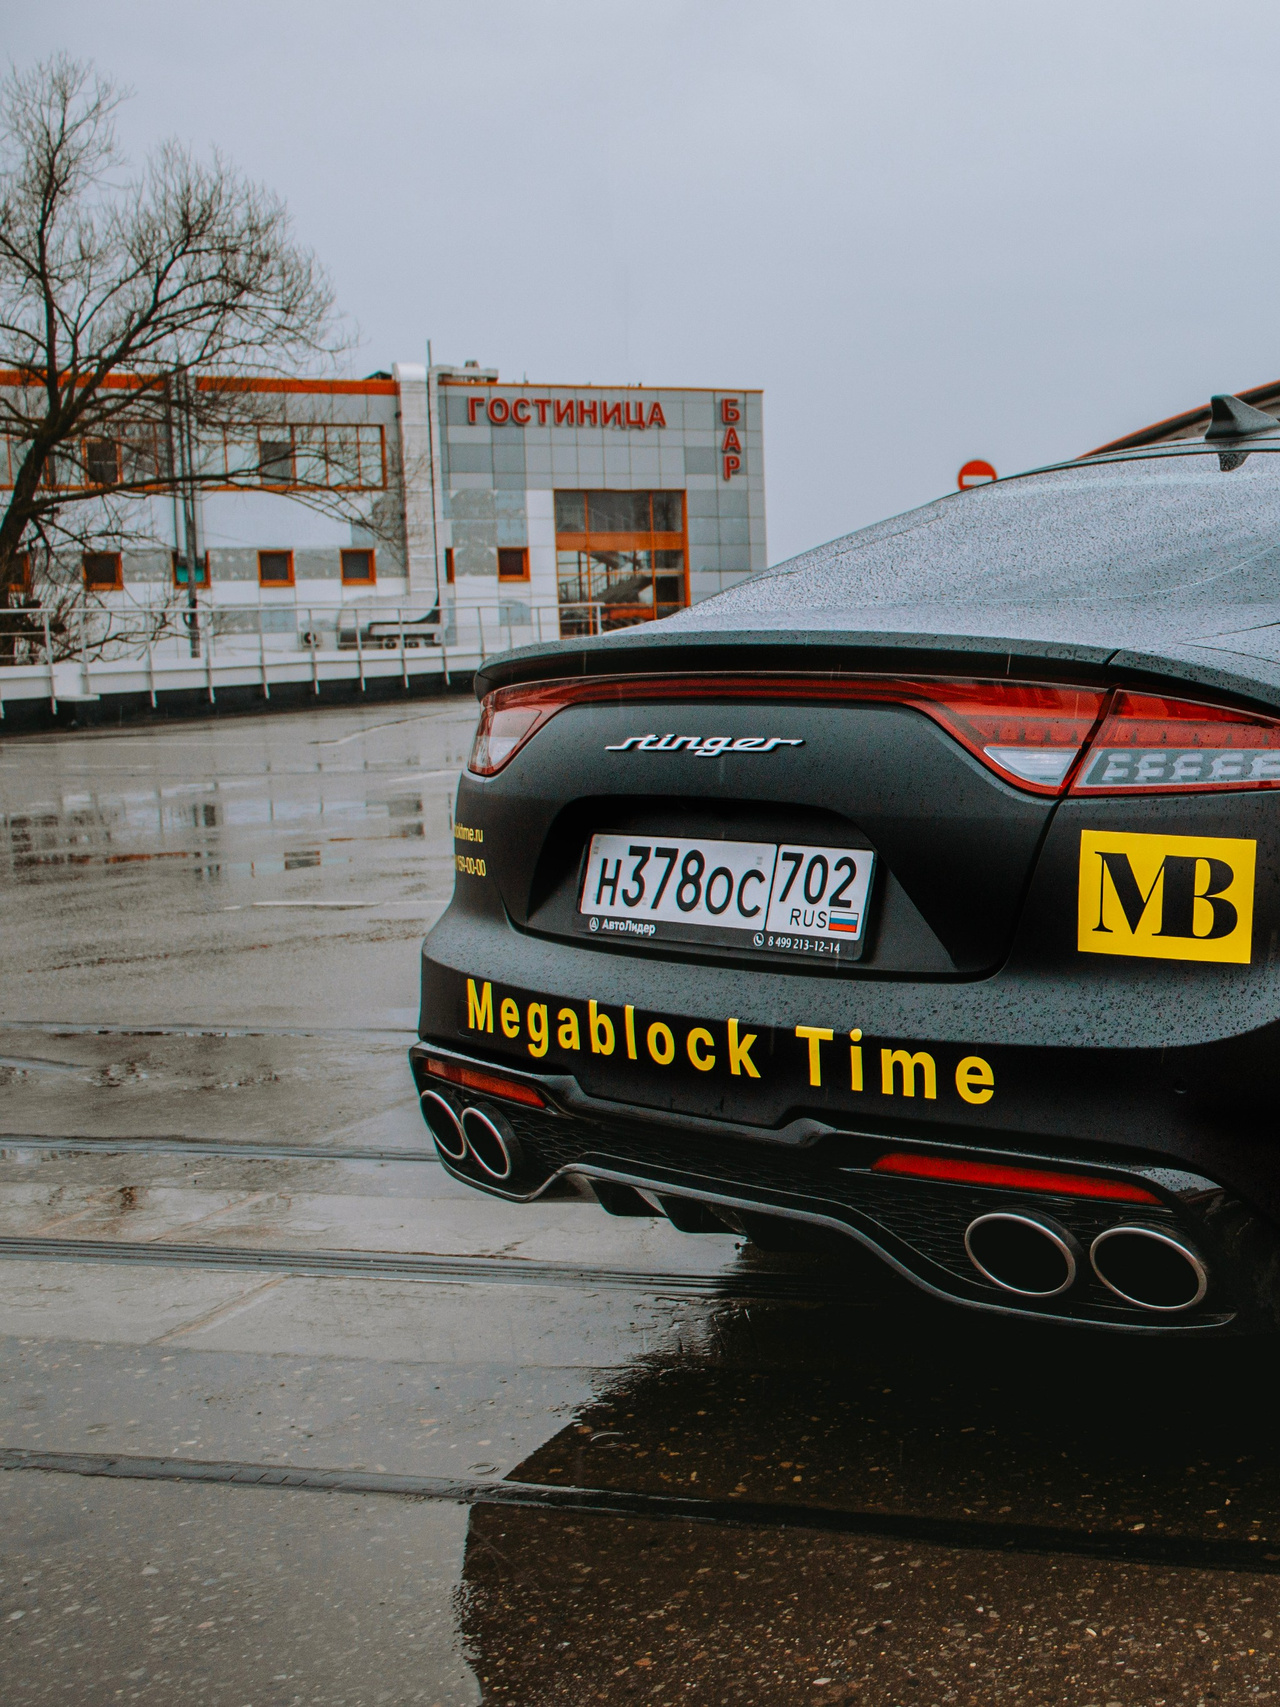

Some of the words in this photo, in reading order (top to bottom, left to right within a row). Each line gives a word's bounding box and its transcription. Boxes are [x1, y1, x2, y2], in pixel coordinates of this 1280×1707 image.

[467, 397, 667, 429] ГОСТИНИЦА
[720, 398, 742, 480] БАР
[605, 734, 804, 757] stinger
[779, 851, 857, 908] 702
[1092, 851, 1238, 940] MB
[601, 918, 656, 936] АвтоЛидер
[790, 908, 828, 929] RUS
[767, 935, 774, 947] 8
[775, 937, 792, 949] 499
[793, 938, 841, 954] 213-12-14
[466, 978, 762, 1078] Megablock
[795, 1025, 995, 1104] Time
